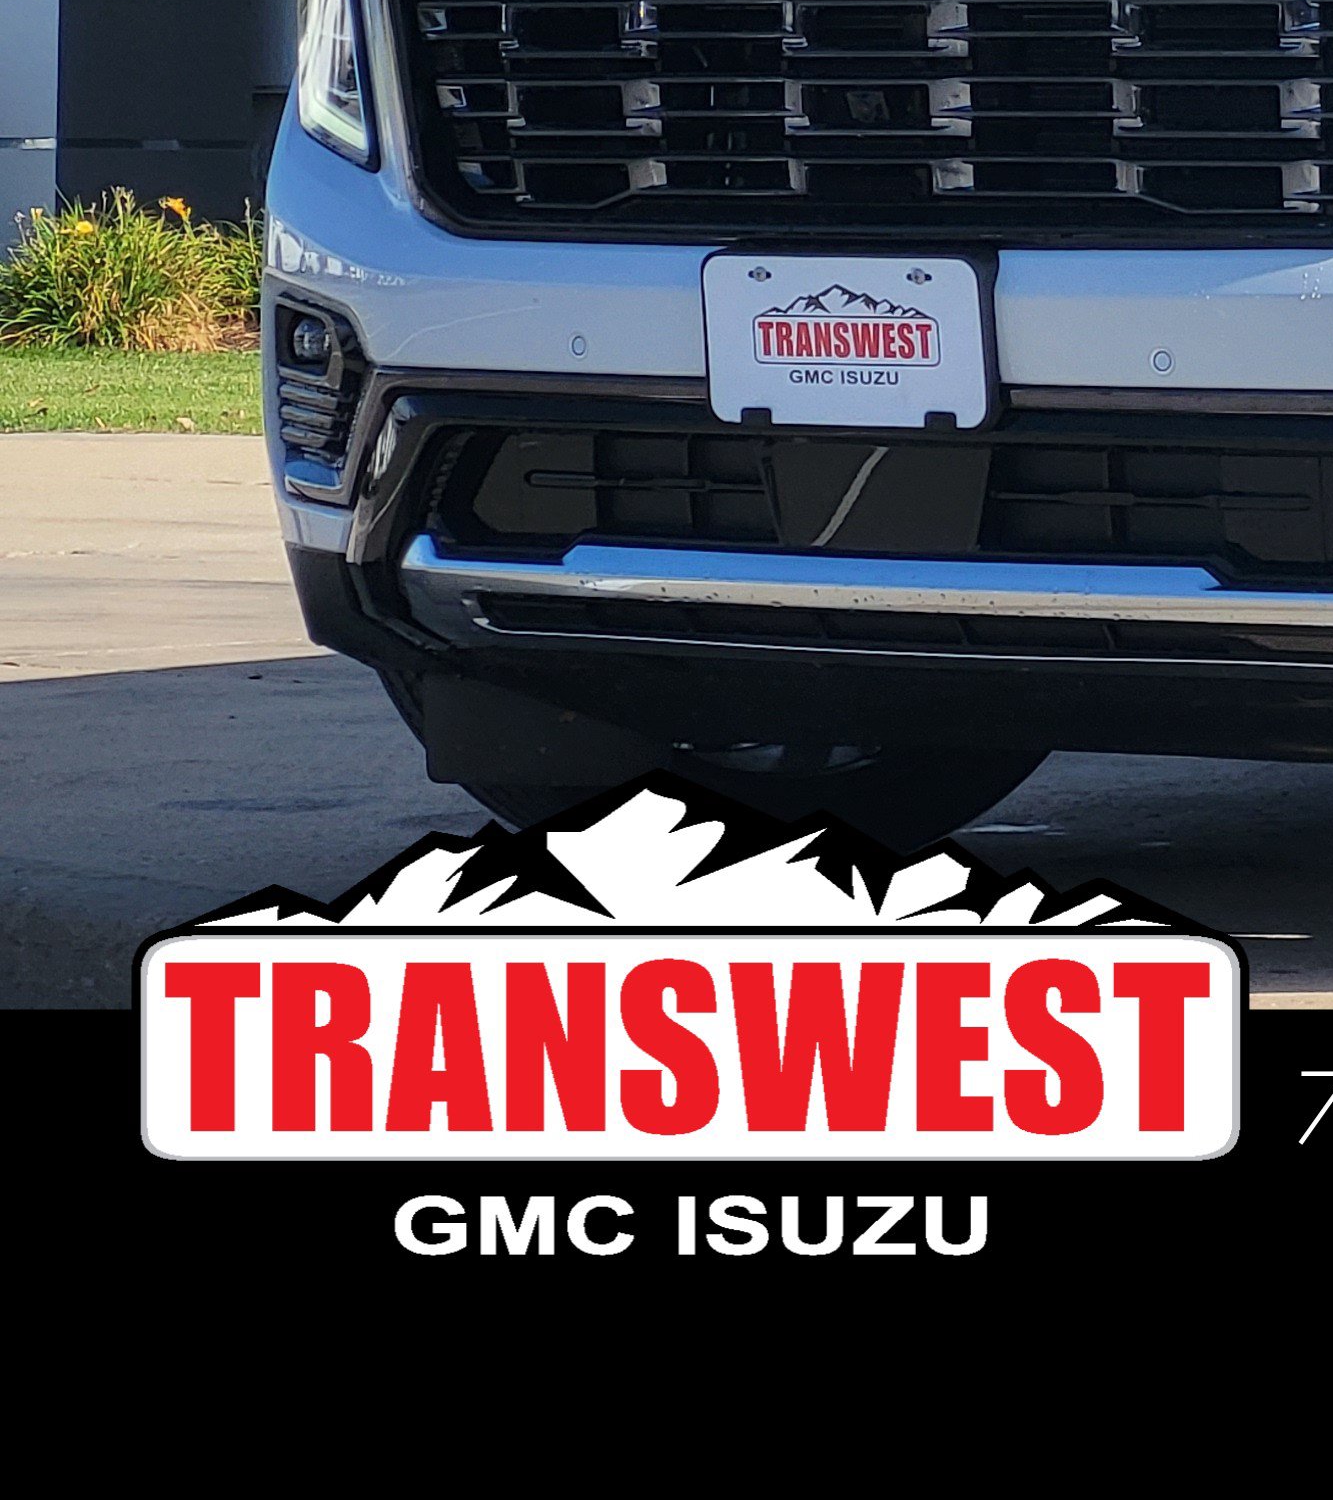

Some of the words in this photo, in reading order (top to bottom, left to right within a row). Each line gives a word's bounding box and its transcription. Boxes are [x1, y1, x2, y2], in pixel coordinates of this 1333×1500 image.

[758, 322, 932, 359] TRANSWEST
[789, 370, 834, 385] GMC
[841, 371, 900, 386] ISUZU
